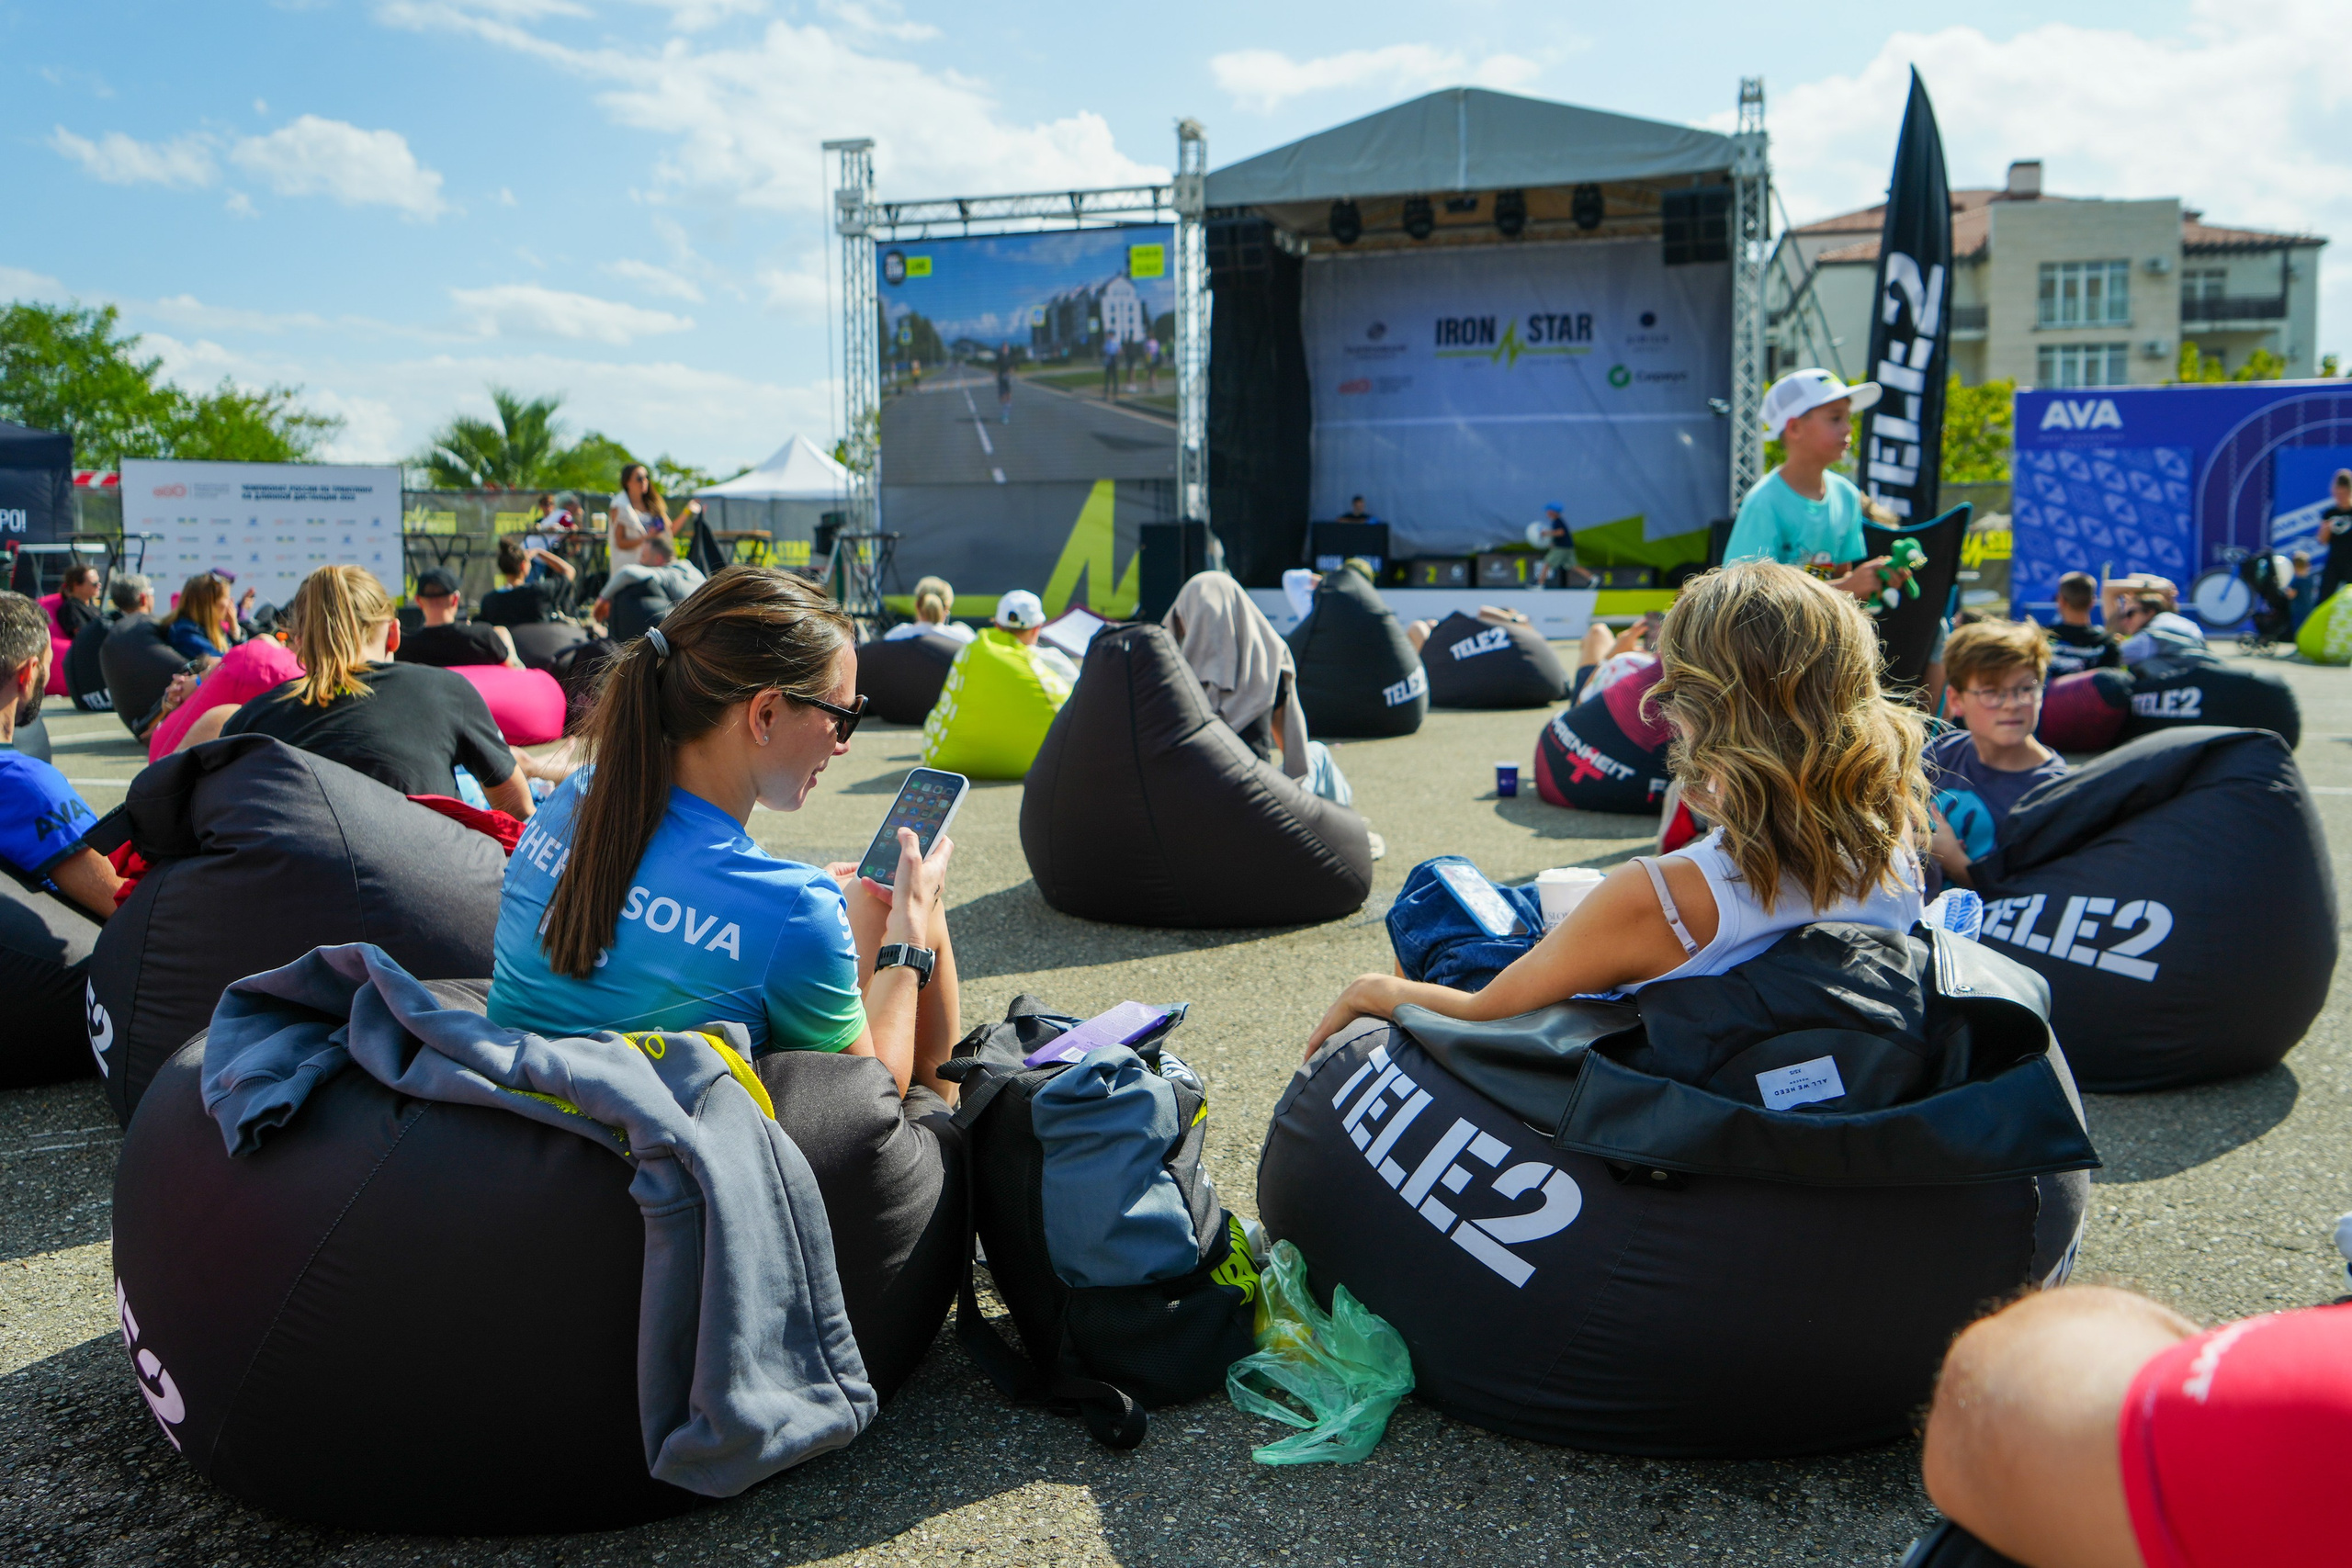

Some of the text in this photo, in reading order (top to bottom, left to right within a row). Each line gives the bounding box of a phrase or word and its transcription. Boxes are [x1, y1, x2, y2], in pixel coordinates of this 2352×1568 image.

[1435, 312, 1593, 347] IRON STAR
[2039, 399, 2124, 432] AVA
[1513, 557, 1527, 583] 1
[1449, 626, 1512, 661] TELE2
[2131, 686, 2202, 718] TELE2
[34, 797, 91, 842] AVA
[1981, 893, 2174, 982] TELE2
[1774, 1087, 1796, 1097] NEED
[1811, 1077, 1828, 1088] ALL
[1331, 1044, 1583, 1289] TELE2
